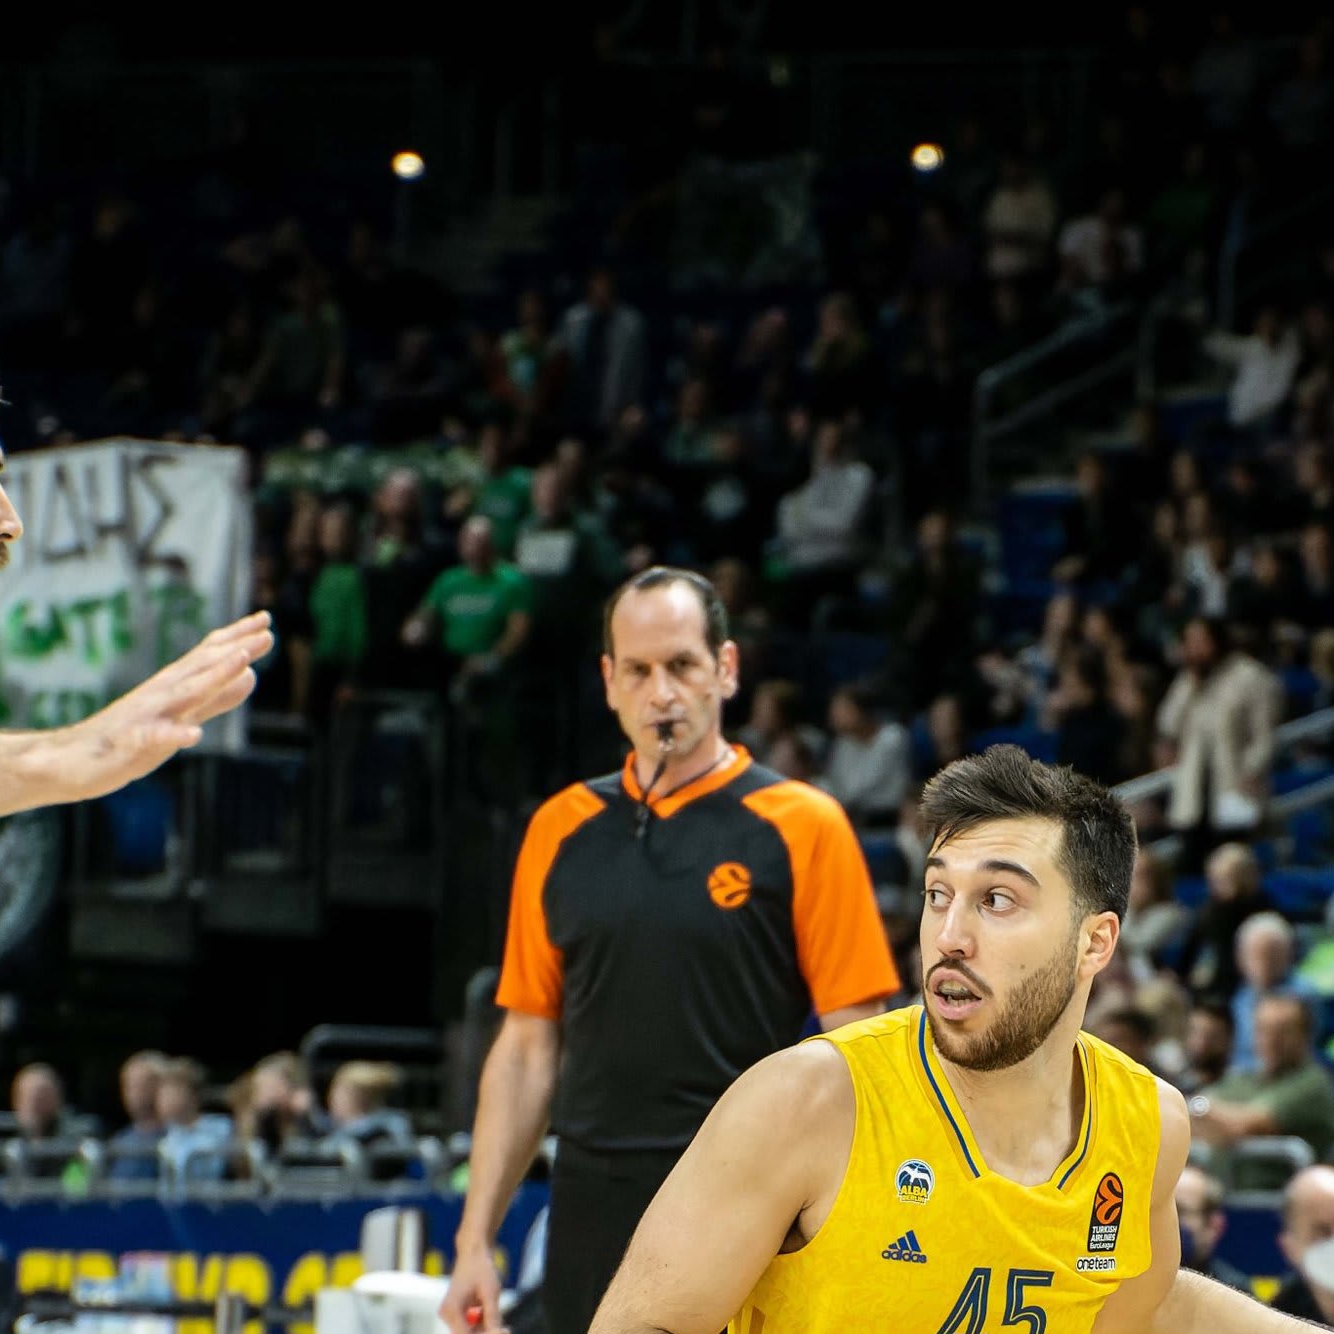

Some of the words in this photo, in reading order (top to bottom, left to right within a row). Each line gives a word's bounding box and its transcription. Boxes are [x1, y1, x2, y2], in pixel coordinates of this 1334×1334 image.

[900, 1184, 928, 1197] ALBA
[1092, 1225, 1118, 1234] TURKISH
[1090, 1233, 1116, 1242] AIRLINES
[881, 1249, 927, 1263] adidas
